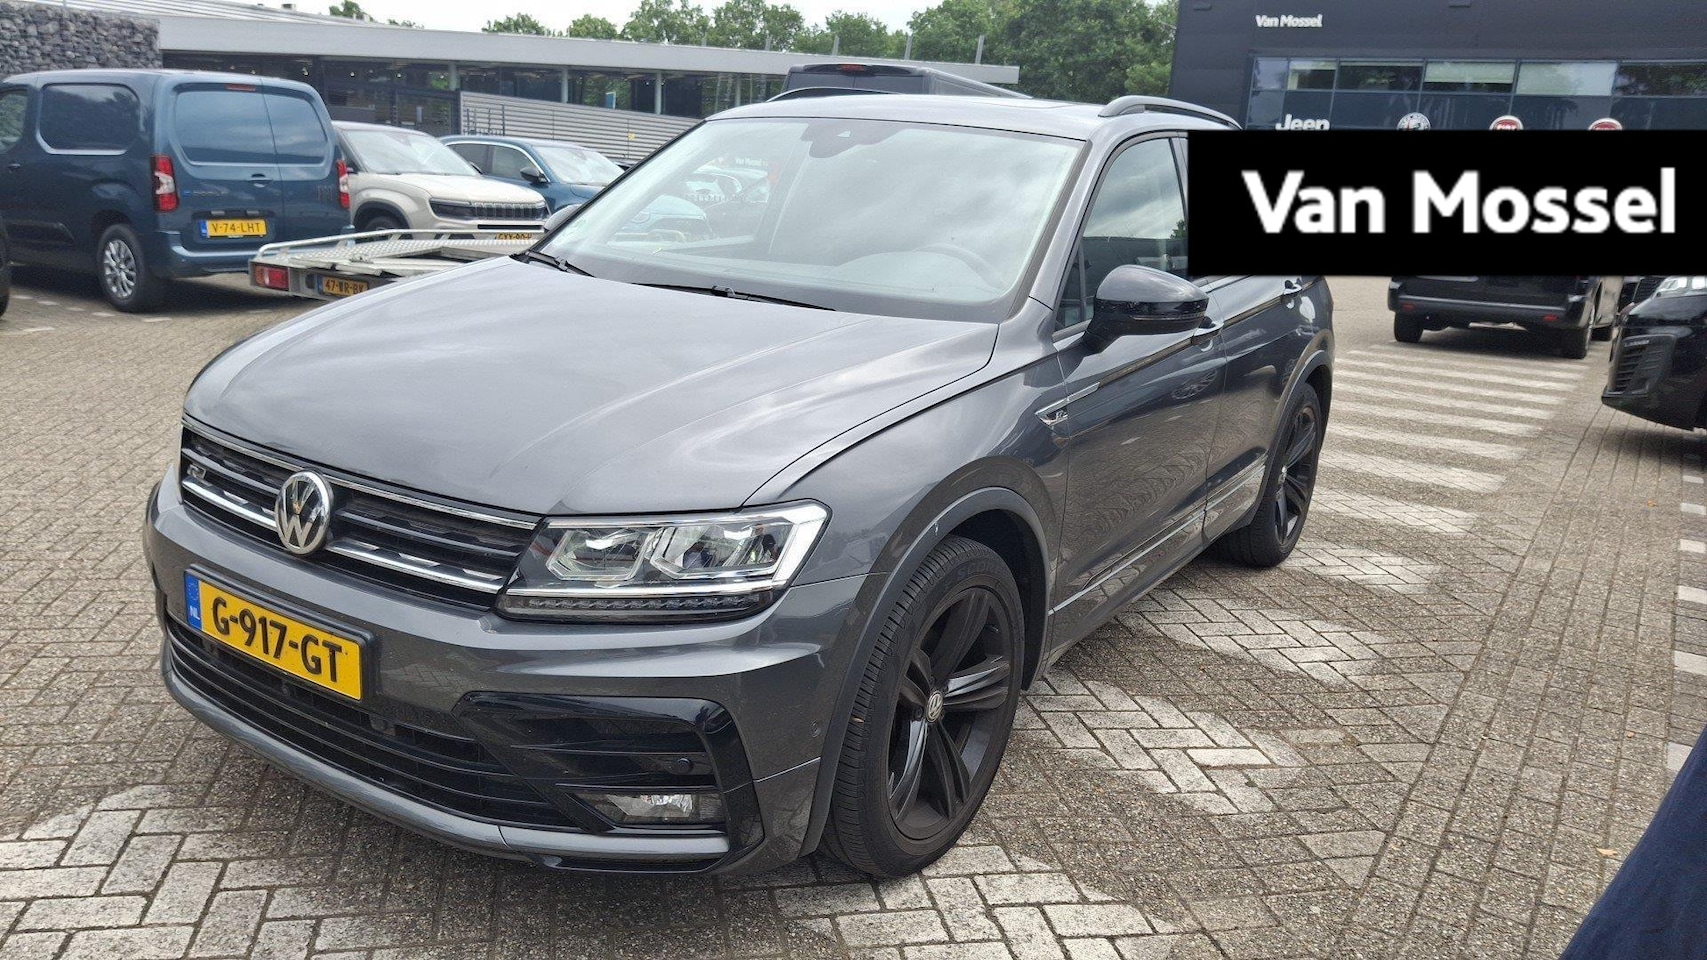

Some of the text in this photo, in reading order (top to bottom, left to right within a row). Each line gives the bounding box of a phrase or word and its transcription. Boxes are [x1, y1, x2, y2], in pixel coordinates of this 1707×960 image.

[1255, 13, 1323, 27] Van Mossel
[212, 222, 261, 233] V-74-LHT
[189, 605, 201, 620] NL
[212, 597, 342, 683] G-917-GT
